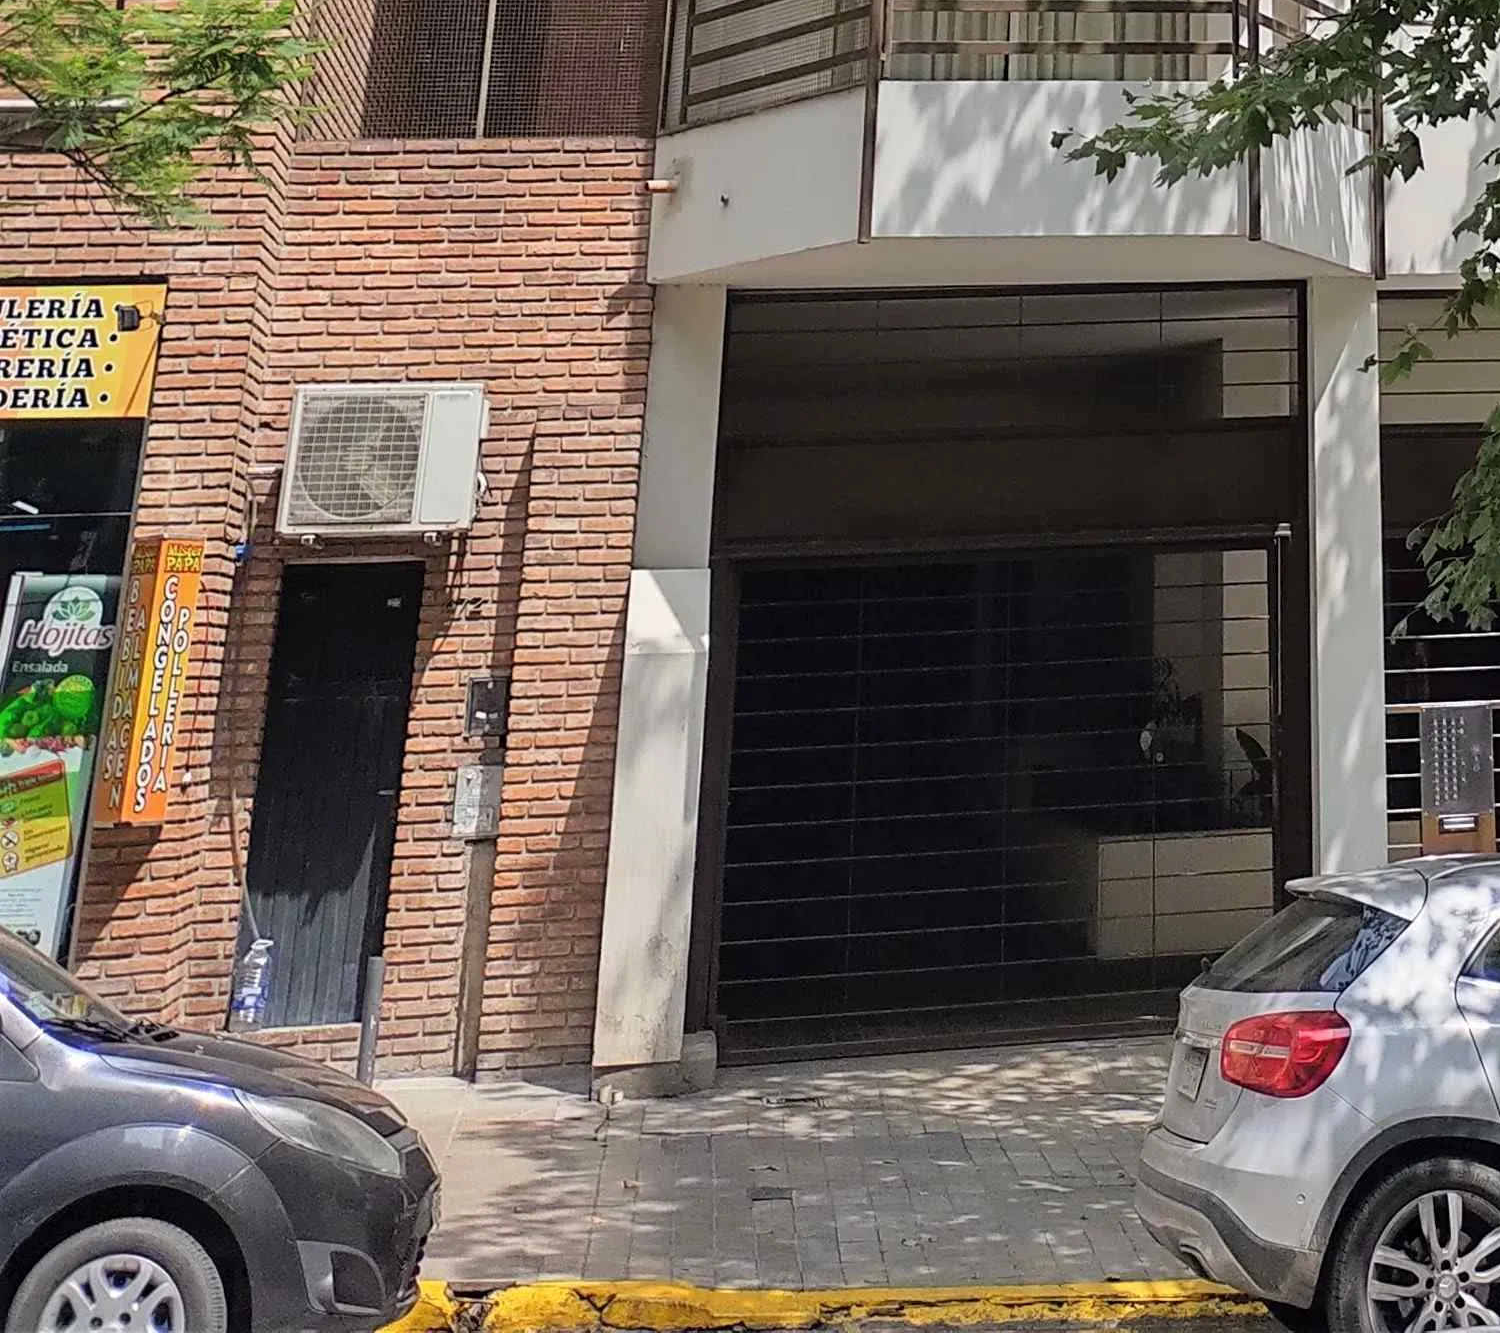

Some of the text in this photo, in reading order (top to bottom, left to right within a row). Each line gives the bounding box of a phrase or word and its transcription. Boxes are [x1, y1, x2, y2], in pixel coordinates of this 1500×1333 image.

[165, 556, 201, 572] PAPA
[12, 660, 69, 673] Ensalada
[17, 619, 117, 657] Hojitas
[104, 577, 140, 781] BEBIDAS
[134, 575, 179, 813] CONGELADOS
[152, 607, 191, 793] POLLERIA
